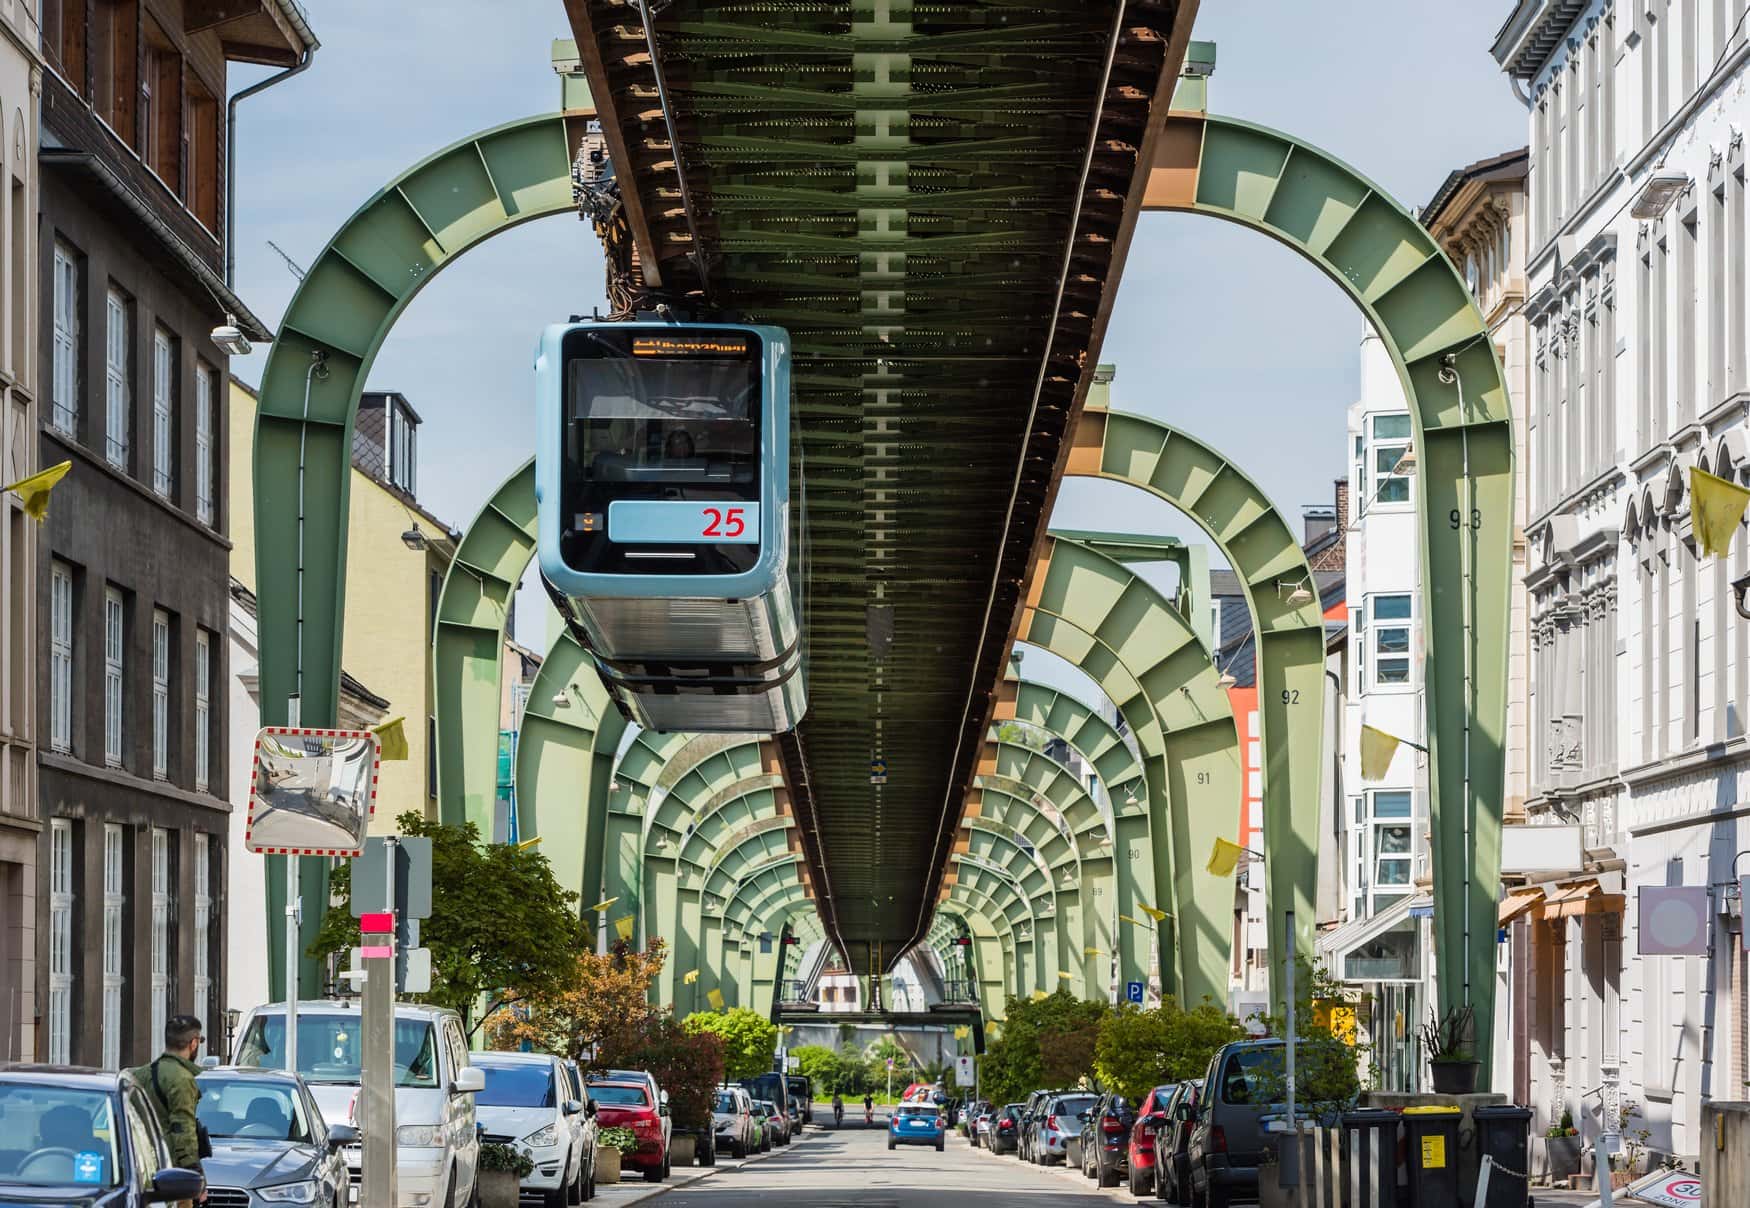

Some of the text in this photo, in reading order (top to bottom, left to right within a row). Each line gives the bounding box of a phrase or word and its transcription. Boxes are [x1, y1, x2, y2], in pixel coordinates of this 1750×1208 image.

[703, 508, 745, 537] 25
[1450, 509, 1481, 529] 93
[1281, 690, 1300, 705] 92
[1197, 772, 1210, 785] 91
[1128, 849, 1140, 859] 90
[1131, 984, 1140, 1000] P
